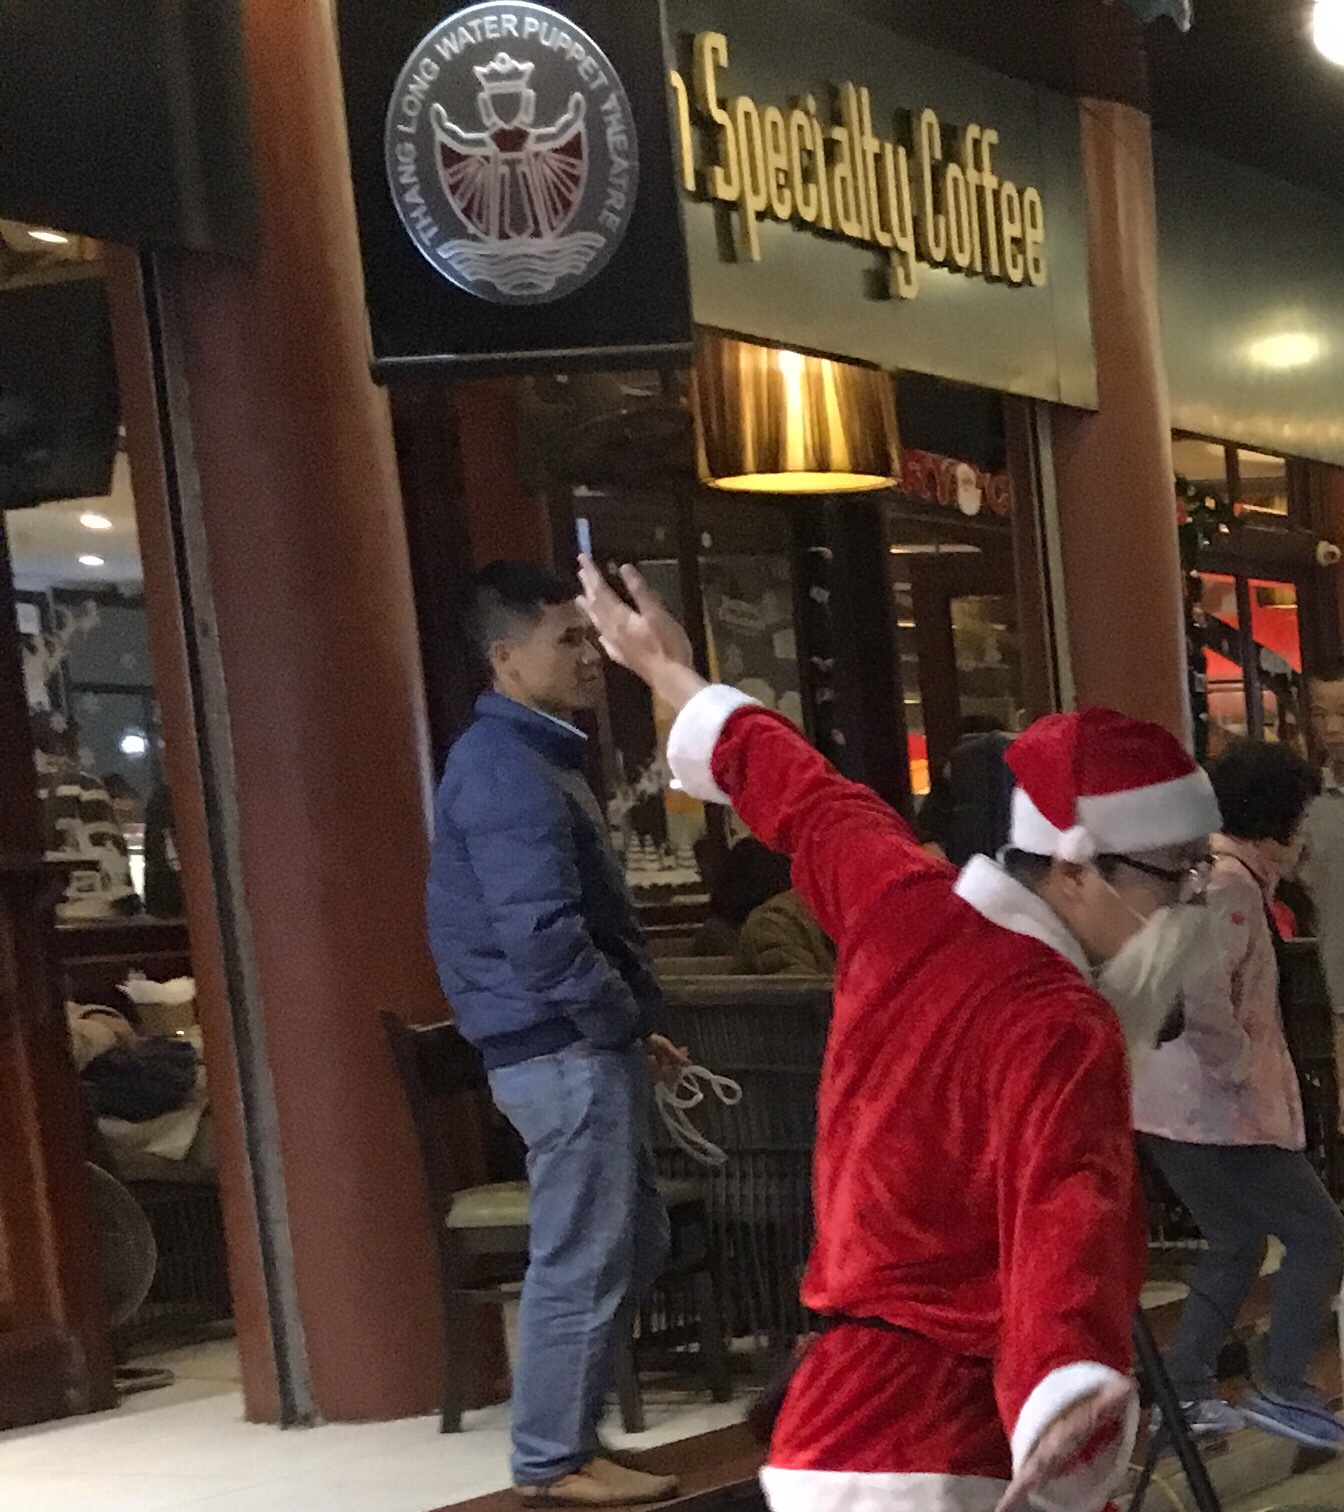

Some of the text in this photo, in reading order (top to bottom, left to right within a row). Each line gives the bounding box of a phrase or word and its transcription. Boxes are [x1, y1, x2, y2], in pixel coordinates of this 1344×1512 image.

[434, 14, 519, 62] WATER
[523, 16, 610, 91] PUPPET
[396, 57, 441, 134] LONG
[395, 142, 439, 247] THANG
[597, 91, 631, 235] THEATRE
[695, 30, 918, 300] Specialty
[919, 107, 1048, 288] Coffee
